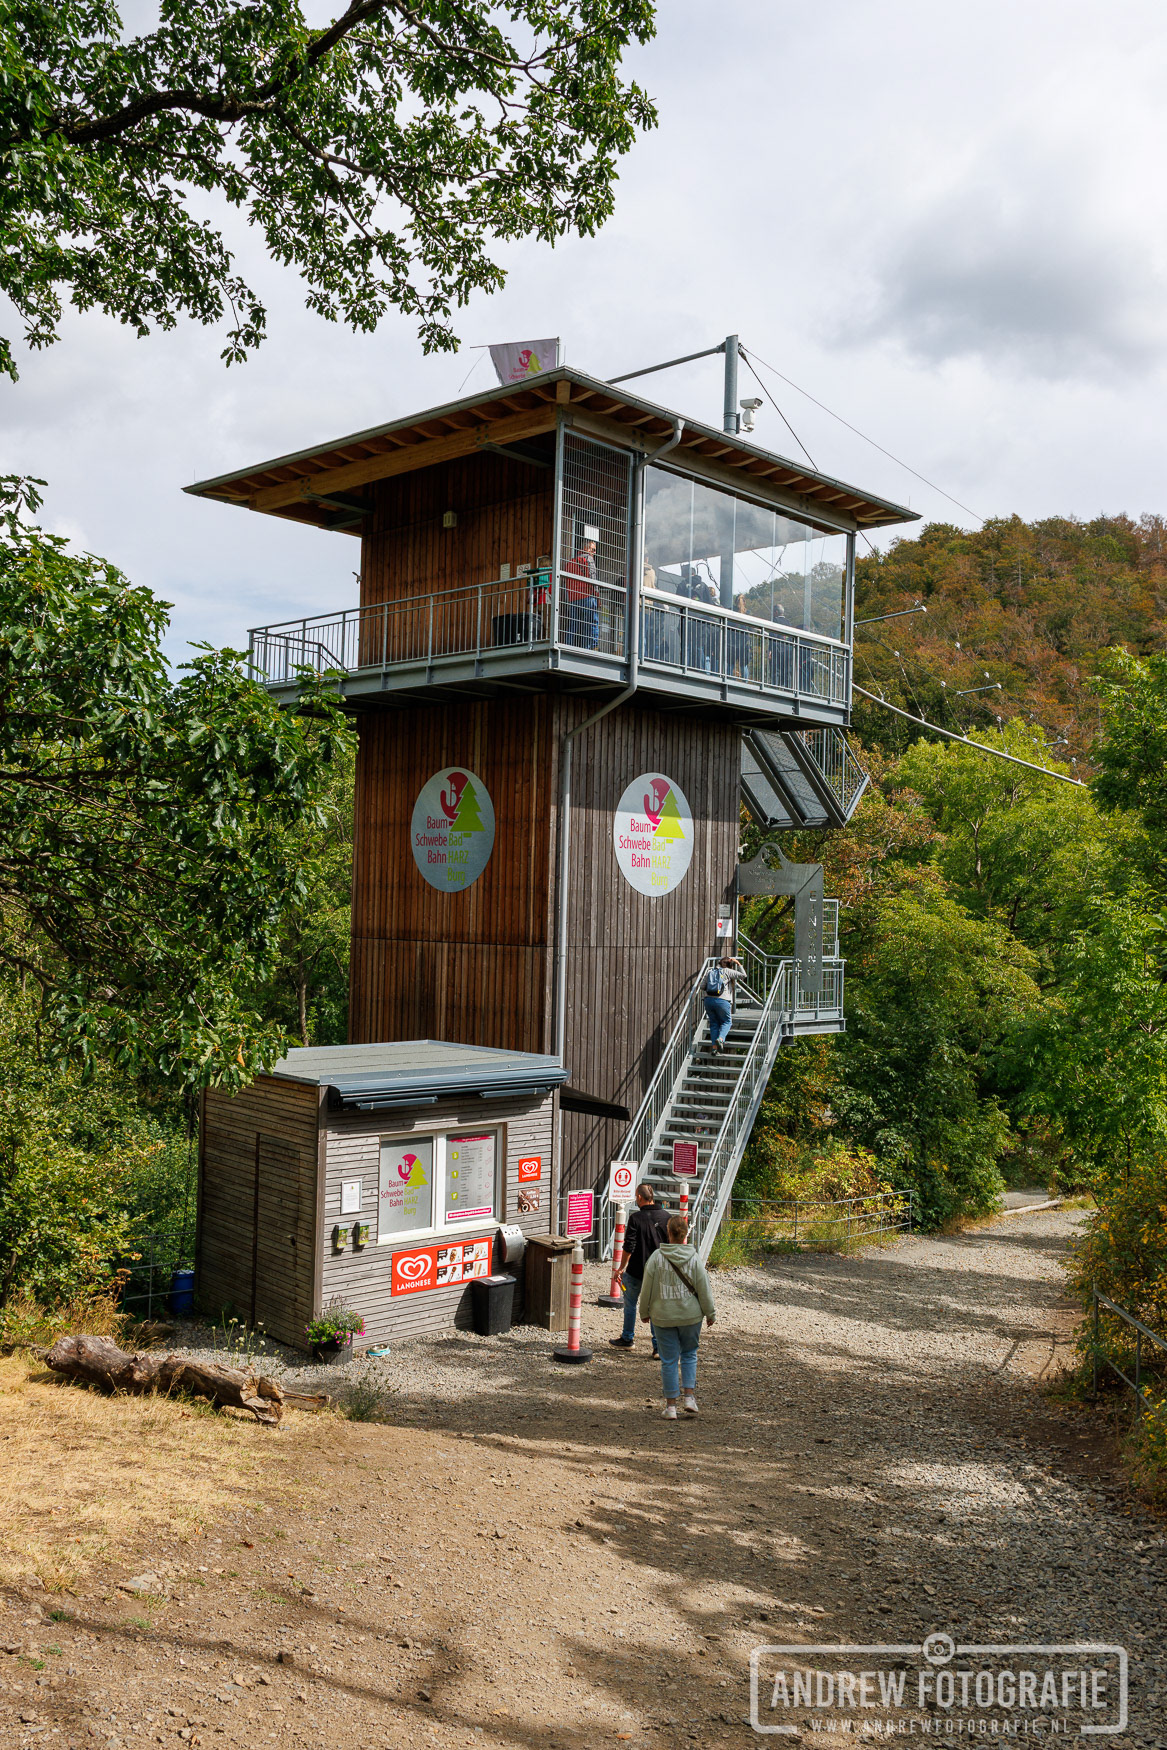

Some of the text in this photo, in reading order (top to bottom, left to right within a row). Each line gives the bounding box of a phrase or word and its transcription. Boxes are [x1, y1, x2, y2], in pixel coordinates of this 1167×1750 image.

[427, 816, 448, 829] Baum
[630, 818, 651, 833] Baum
[415, 832, 463, 847] Schwebe Bad
[619, 835, 666, 851] Schwebe Bad
[427, 849, 469, 864] Bahn HARZ
[631, 853, 672, 869] Bahn HARZ
[447, 867, 465, 886] Burg
[651, 872, 668, 890] Burg
[388, 1180, 404, 1188] Baum
[380, 1187, 415, 1199] Schwebe Bad
[389, 1198, 404, 1207] Bahn
[403, 1206, 417, 1216] Burg
[396, 1278, 432, 1291] LANGNESE
